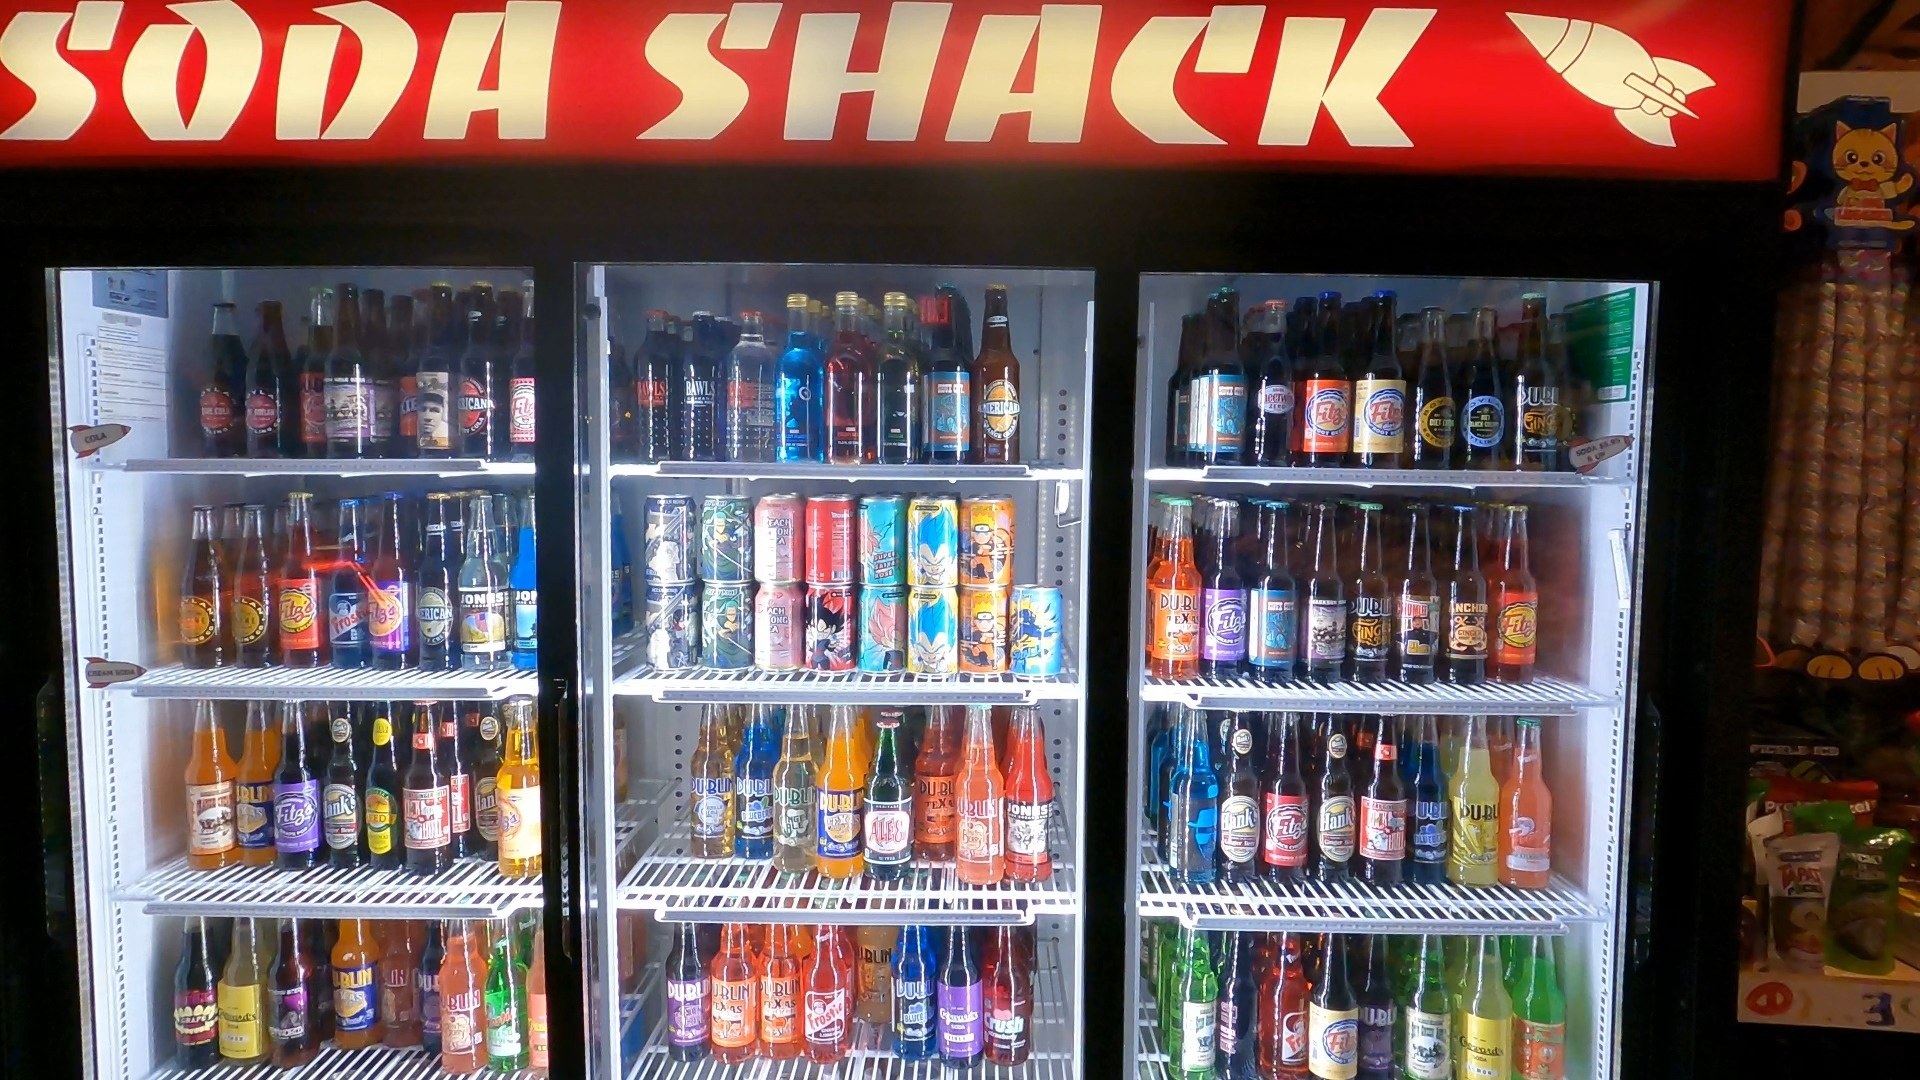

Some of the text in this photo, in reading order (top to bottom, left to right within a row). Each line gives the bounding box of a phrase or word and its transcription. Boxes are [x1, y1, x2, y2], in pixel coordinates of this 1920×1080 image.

[0, 0, 1438, 148] SODA SHACK
[685, 380, 716, 396] BAWLS
[84, 432, 108, 444] COLA
[461, 592, 504, 605] JONES
[276, 801, 315, 826] Fitz's
[1007, 803, 1048, 817] JONES
[807, 1002, 843, 1031] Frostie
[985, 1016, 1024, 1034] Crush
